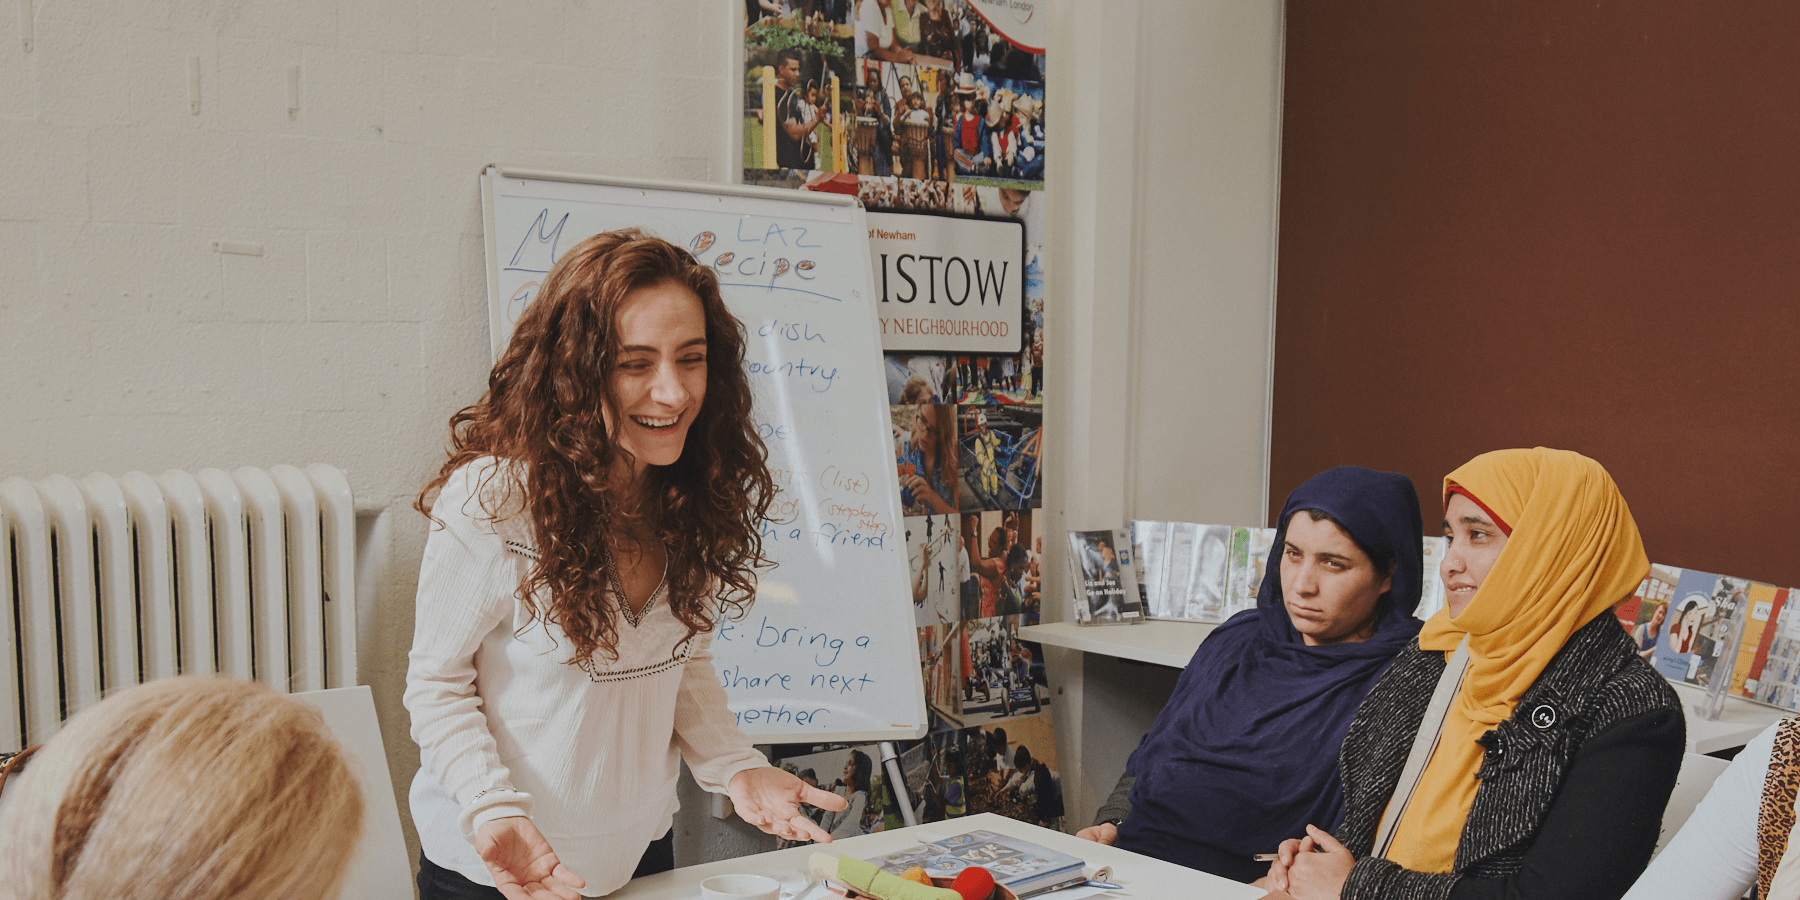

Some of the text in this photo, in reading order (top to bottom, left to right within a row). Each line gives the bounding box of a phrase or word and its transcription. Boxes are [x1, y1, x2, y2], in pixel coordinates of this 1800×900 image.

[1010, 0, 1034, 11] London
[876, 229, 916, 241] Newham
[689, 231, 816, 293] Recipe
[880, 253, 1009, 307] ISTOW
[758, 319, 826, 343] dish
[878, 317, 1009, 337] Y NEIGHBOURHOOD
[820, 465, 870, 496] (list)
[789, 528, 801, 541] a
[812, 522, 894, 551] friend.
[1087, 589, 1095, 597] Go
[1104, 587, 1127, 596] Holiday
[756, 615, 845, 667] bring
[855, 635, 871, 649] a
[722, 664, 876, 695] share next
[735, 703, 832, 729] ether.
